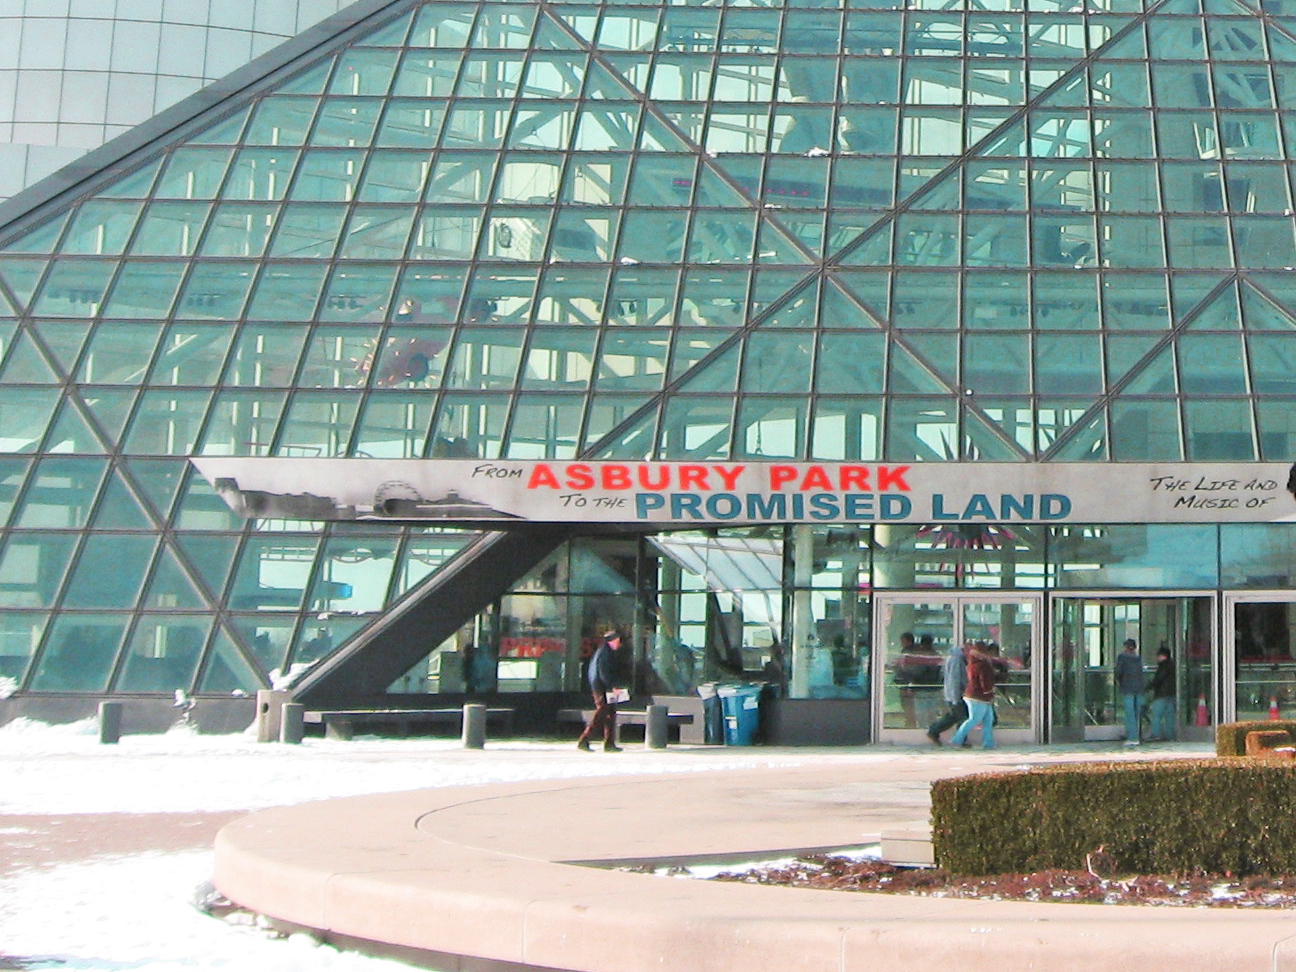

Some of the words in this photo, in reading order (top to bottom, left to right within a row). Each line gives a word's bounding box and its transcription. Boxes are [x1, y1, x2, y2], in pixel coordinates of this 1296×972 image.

[473, 464, 523, 478] FROM
[527, 463, 745, 491] ASBURY
[769, 465, 911, 491] PARK
[1150, 476, 1190, 492] THE
[559, 494, 587, 508] TO
[593, 497, 627, 509] THE
[635, 493, 912, 520] PROMISED
[932, 494, 1073, 520] LAND
[1174, 495, 1239, 509] MUSIC
[1246, 497, 1275, 509] OF
